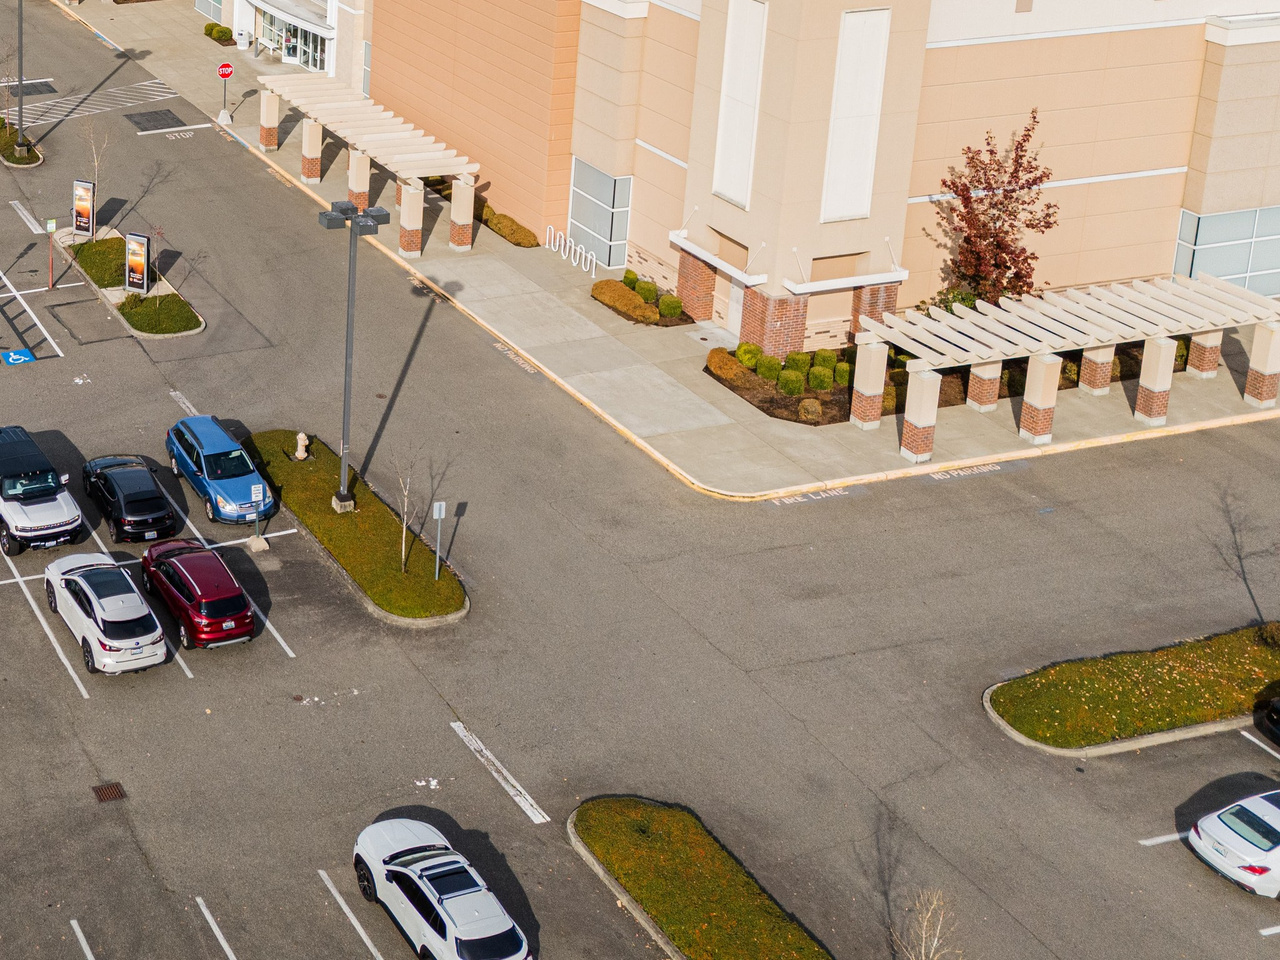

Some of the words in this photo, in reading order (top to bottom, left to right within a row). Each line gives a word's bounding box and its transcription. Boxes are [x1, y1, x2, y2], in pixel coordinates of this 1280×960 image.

[219, 67, 233, 75] STOP
[165, 131, 195, 140] STOP
[492, 342, 509, 351] NO
[503, 350, 538, 374] PARKING
[928, 471, 951, 481] NO
[952, 463, 1001, 478] PARKING
[771, 495, 808, 506] FIRE
[812, 487, 849, 500] LANE
